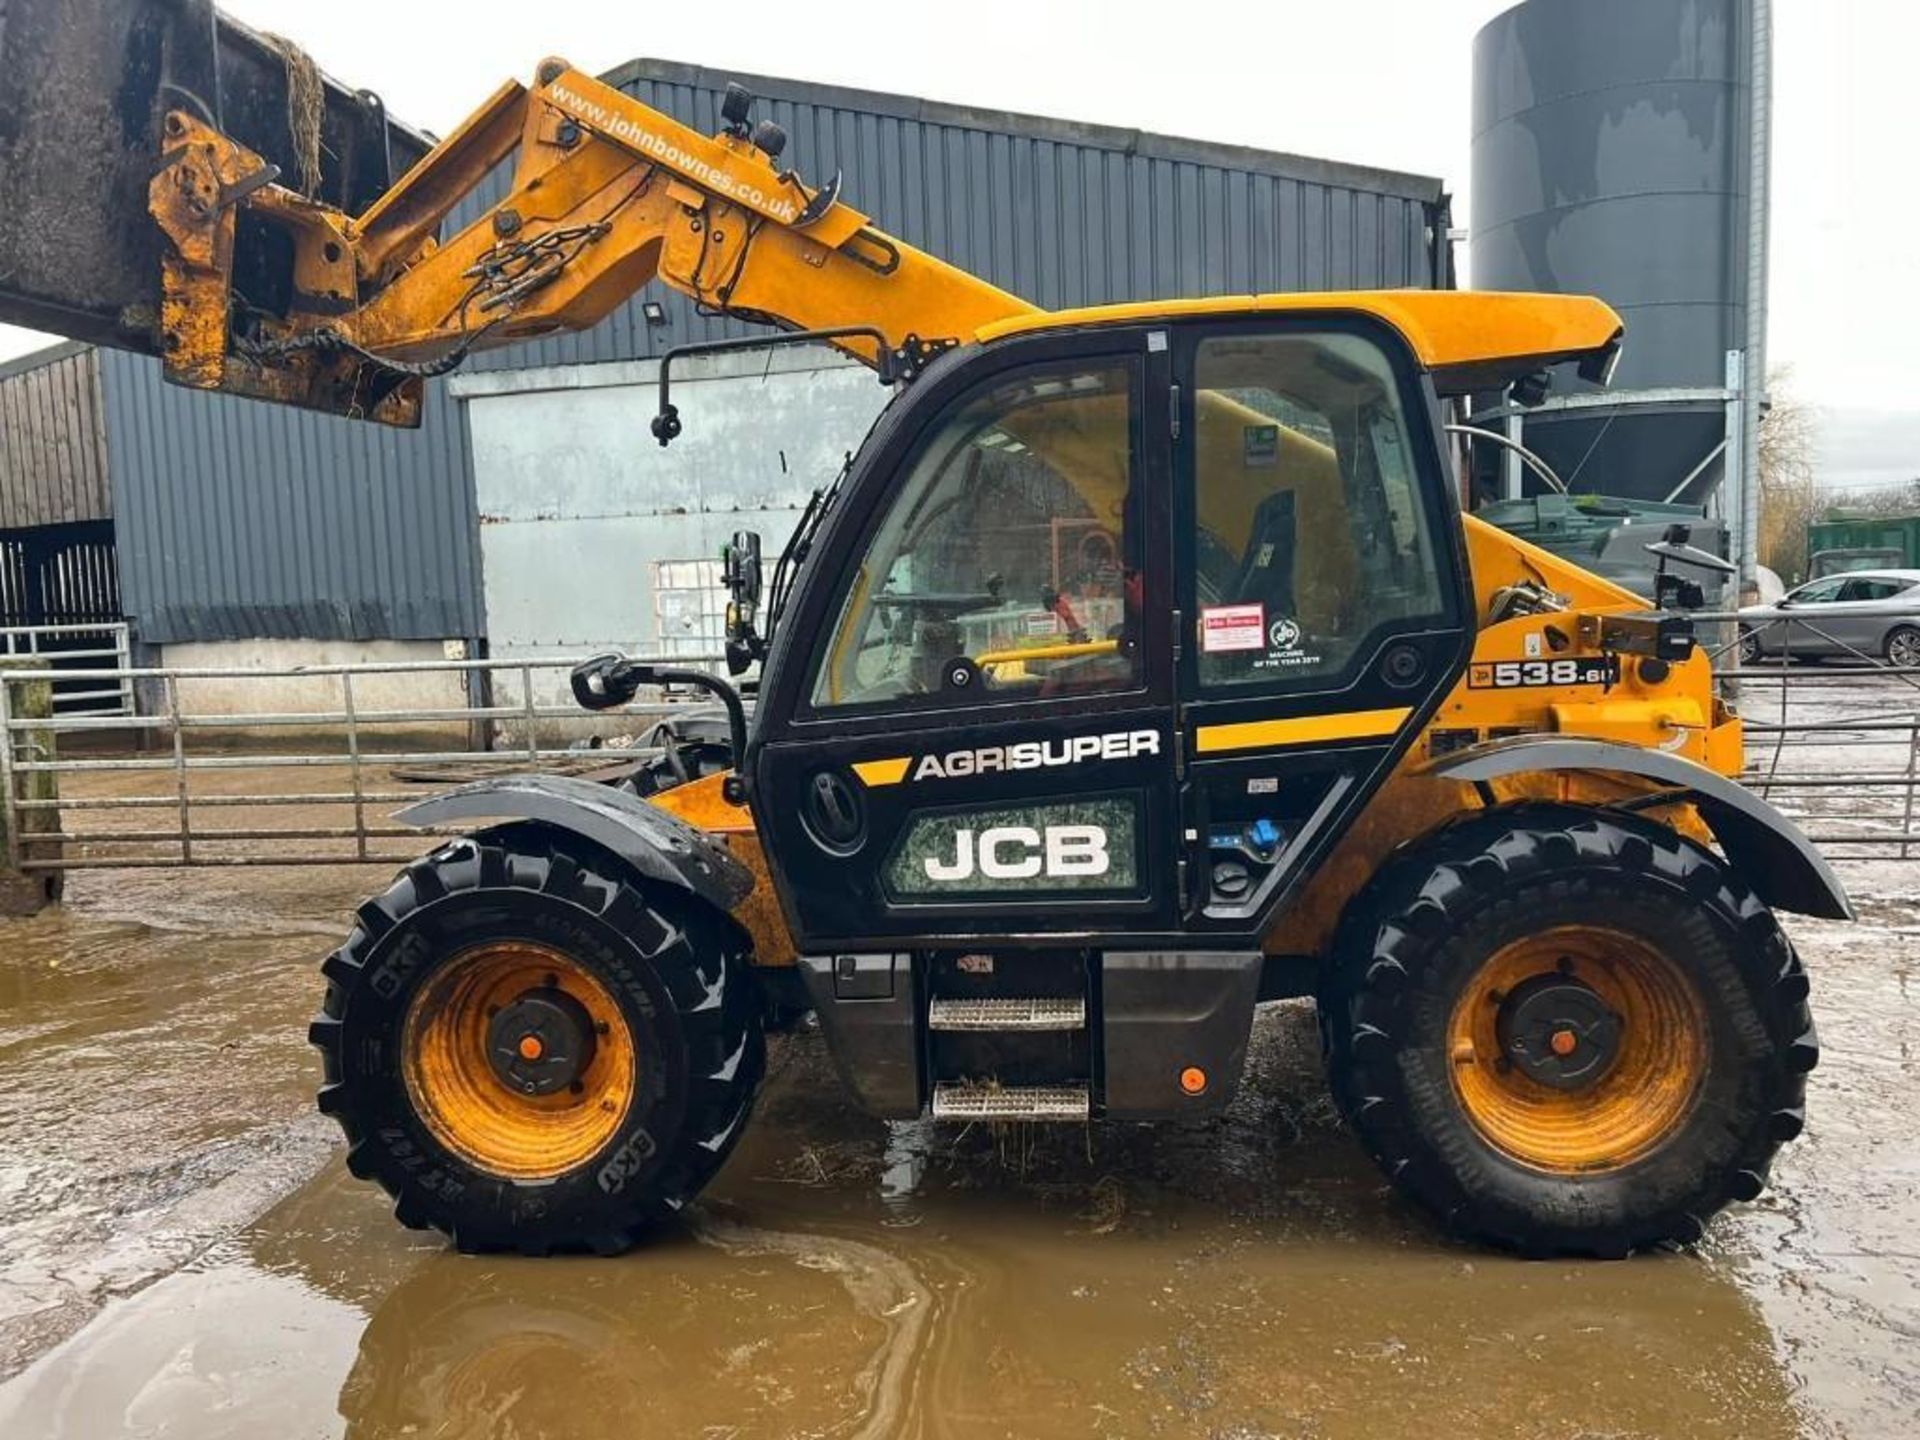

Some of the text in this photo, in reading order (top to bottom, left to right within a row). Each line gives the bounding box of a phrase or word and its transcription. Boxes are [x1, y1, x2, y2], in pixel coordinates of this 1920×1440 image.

[551, 84, 796, 221] www.johnbownes.co.uk
[913, 729, 1160, 782] AGRISUPER
[924, 824, 1110, 881] JCB
[597, 1128, 656, 1194] BKT
